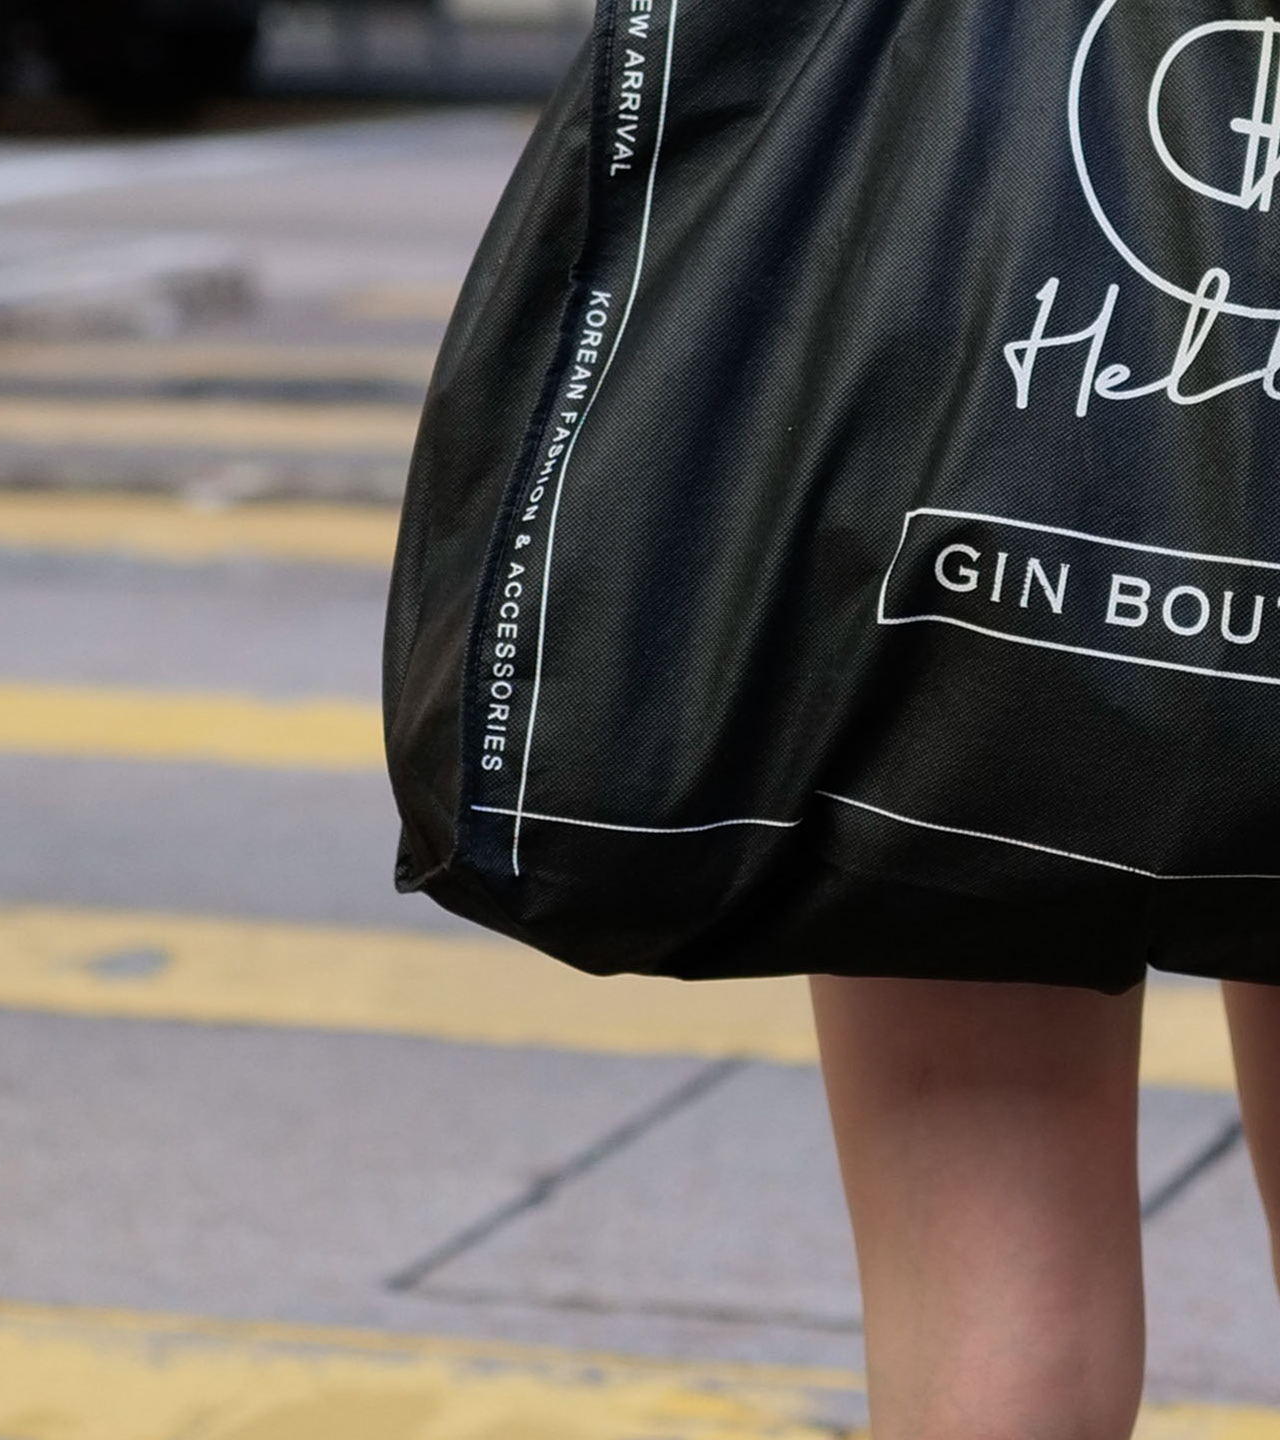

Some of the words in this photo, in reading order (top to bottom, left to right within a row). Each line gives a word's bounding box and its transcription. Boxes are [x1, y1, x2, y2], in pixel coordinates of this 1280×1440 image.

[609, 48, 646, 177] ARRIVAL
[565, 290, 612, 400] KOREAN
[521, 411, 579, 522] FASHION
[514, 533, 532, 550] &
[933, 543, 1071, 614] GIN
[481, 561, 525, 771] ACCESSORIES
